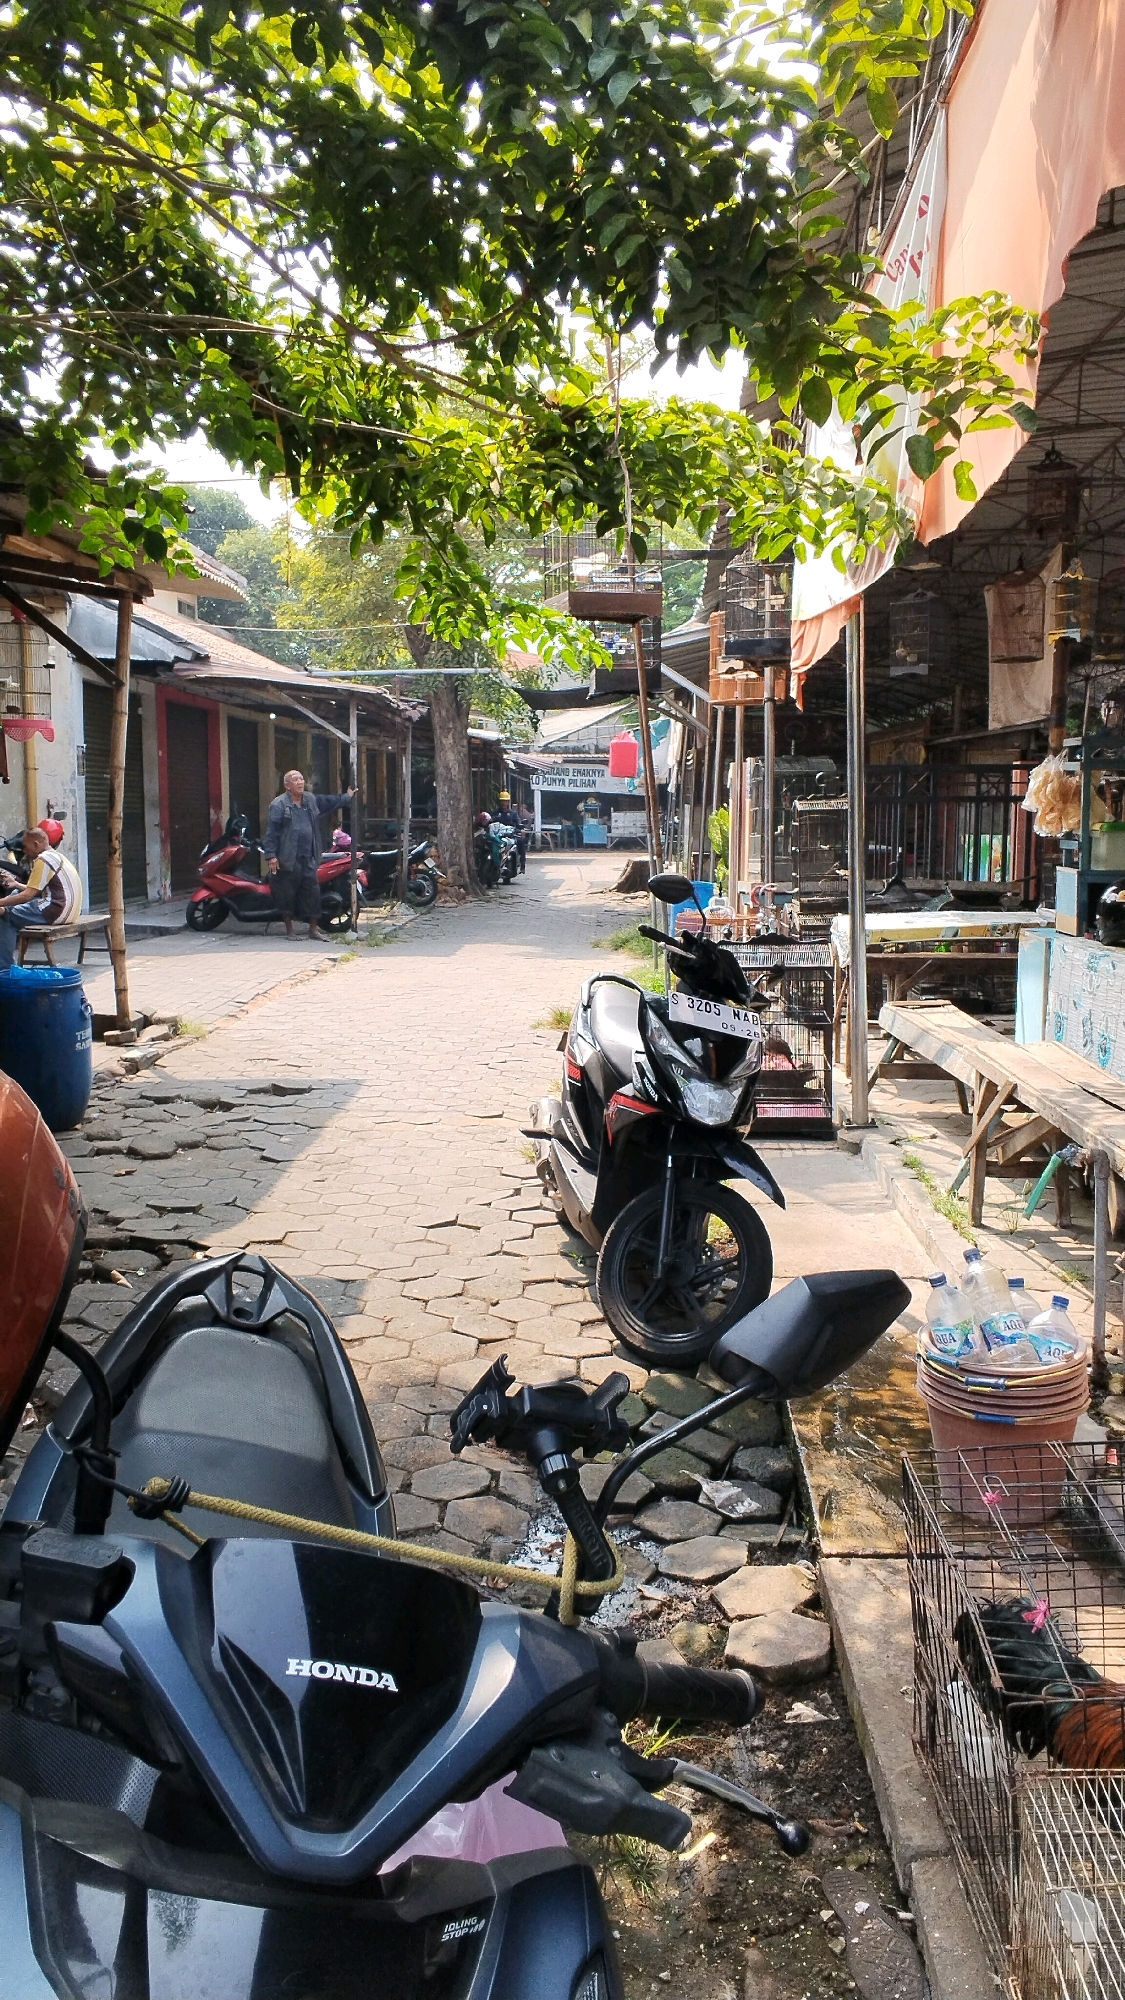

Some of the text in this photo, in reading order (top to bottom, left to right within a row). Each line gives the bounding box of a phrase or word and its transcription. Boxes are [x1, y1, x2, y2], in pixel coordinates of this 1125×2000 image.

[572, 768, 605, 778] ENAKNYA
[567, 778, 597, 788] PILIHAN
[671, 993, 759, 1026] S 3205 NAB
[285, 1657, 399, 1693] HONDA
[444, 1916, 478, 1933] IDLING
[440, 1927, 469, 1942] STOP
